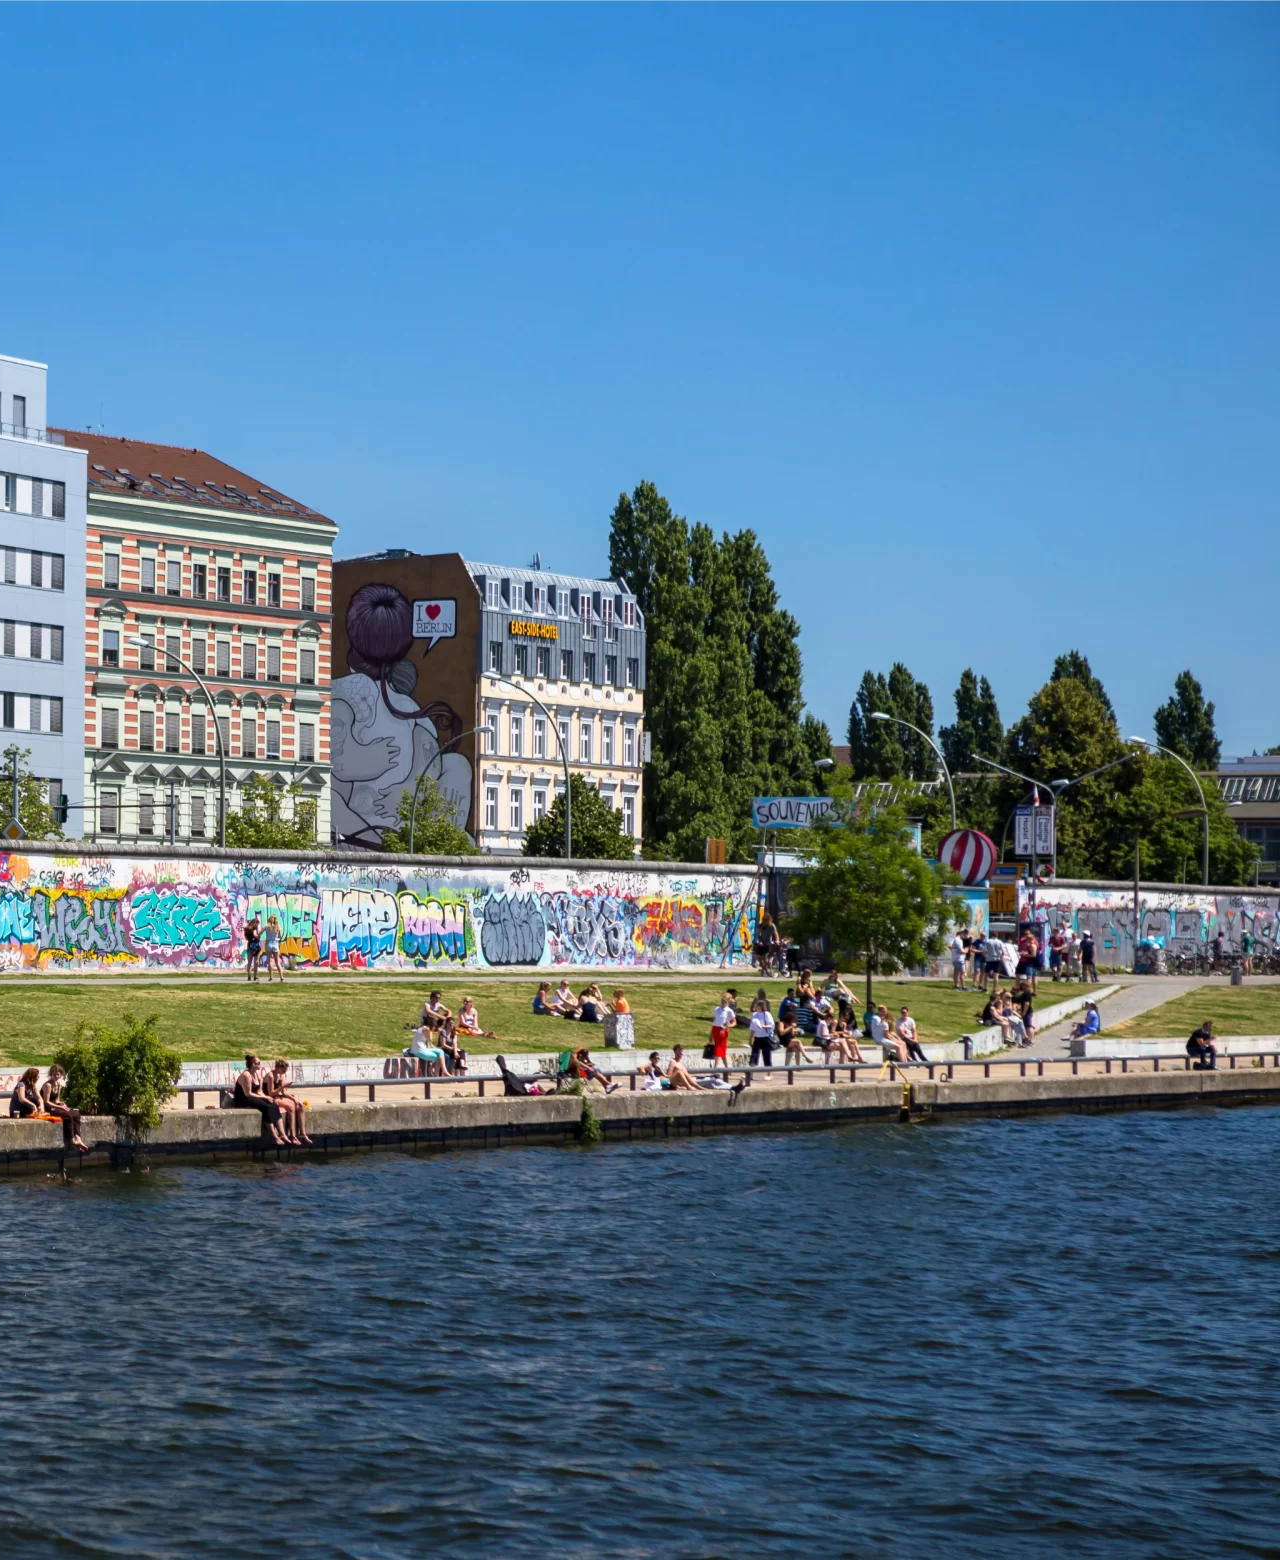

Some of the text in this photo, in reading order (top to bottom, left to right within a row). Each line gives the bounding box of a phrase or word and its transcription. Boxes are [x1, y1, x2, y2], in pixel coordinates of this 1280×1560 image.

[415, 604, 424, 622] I
[415, 622, 452, 633] BERLIN
[756, 800, 841, 824] SOUVENIRS
